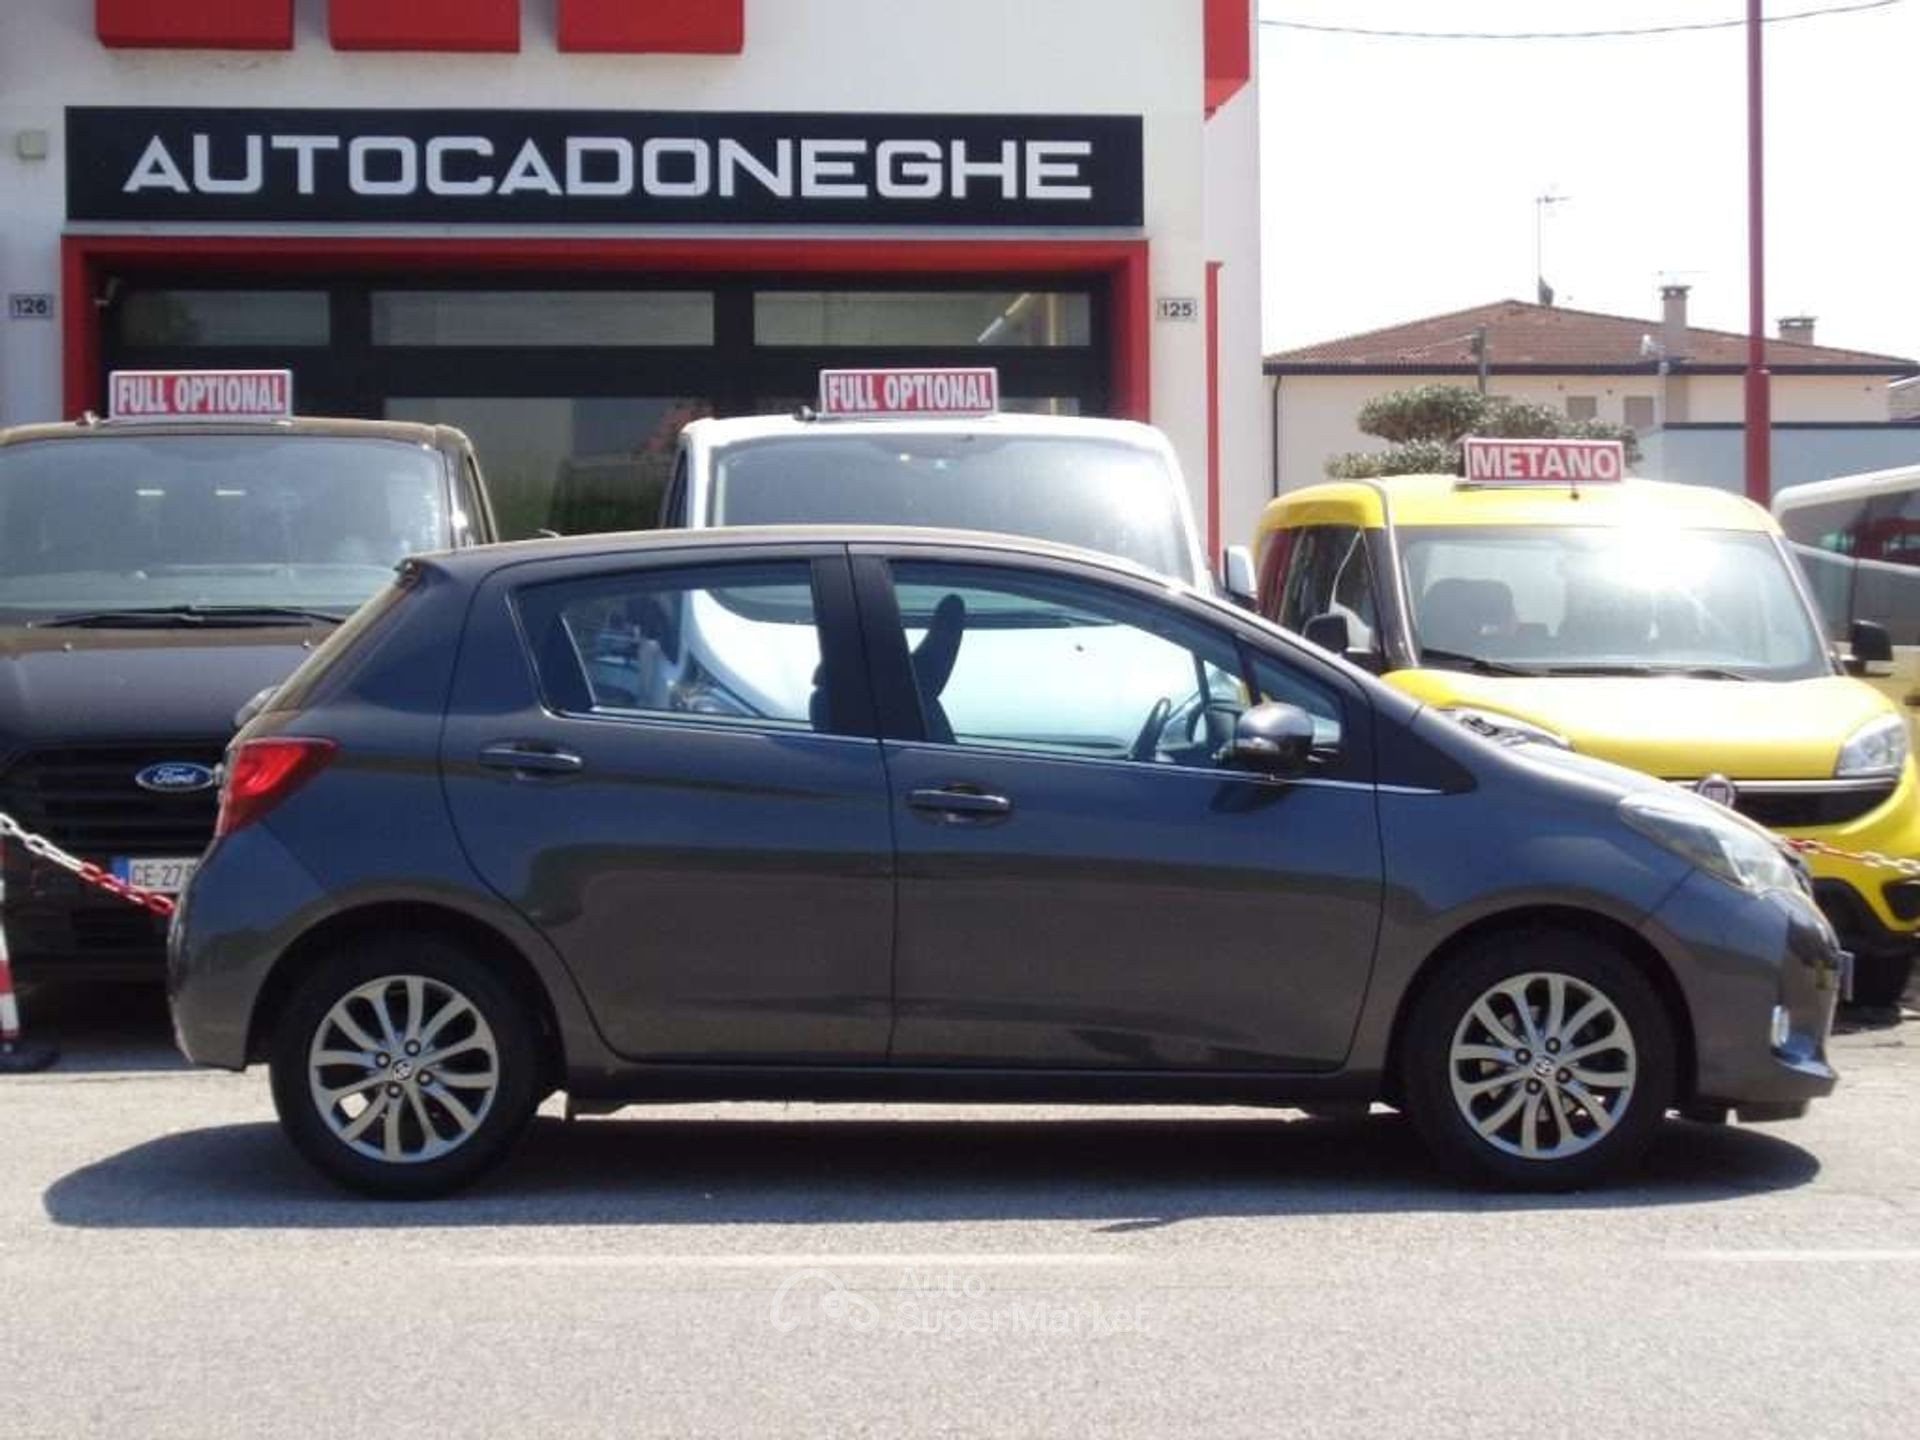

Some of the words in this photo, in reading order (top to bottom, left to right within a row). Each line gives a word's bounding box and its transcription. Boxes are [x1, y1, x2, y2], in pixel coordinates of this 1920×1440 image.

[122, 134, 1092, 198] AUTOCADONEGHE
[15, 298, 47, 315] 126
[1163, 302, 1192, 317] 125
[118, 375, 167, 412] FULL
[174, 374, 284, 412] OPTIONAL
[828, 375, 878, 411] FULL
[883, 373, 991, 410] OPTIONAL
[1471, 445, 1617, 479] METANO
[152, 766, 196, 784] Ford
